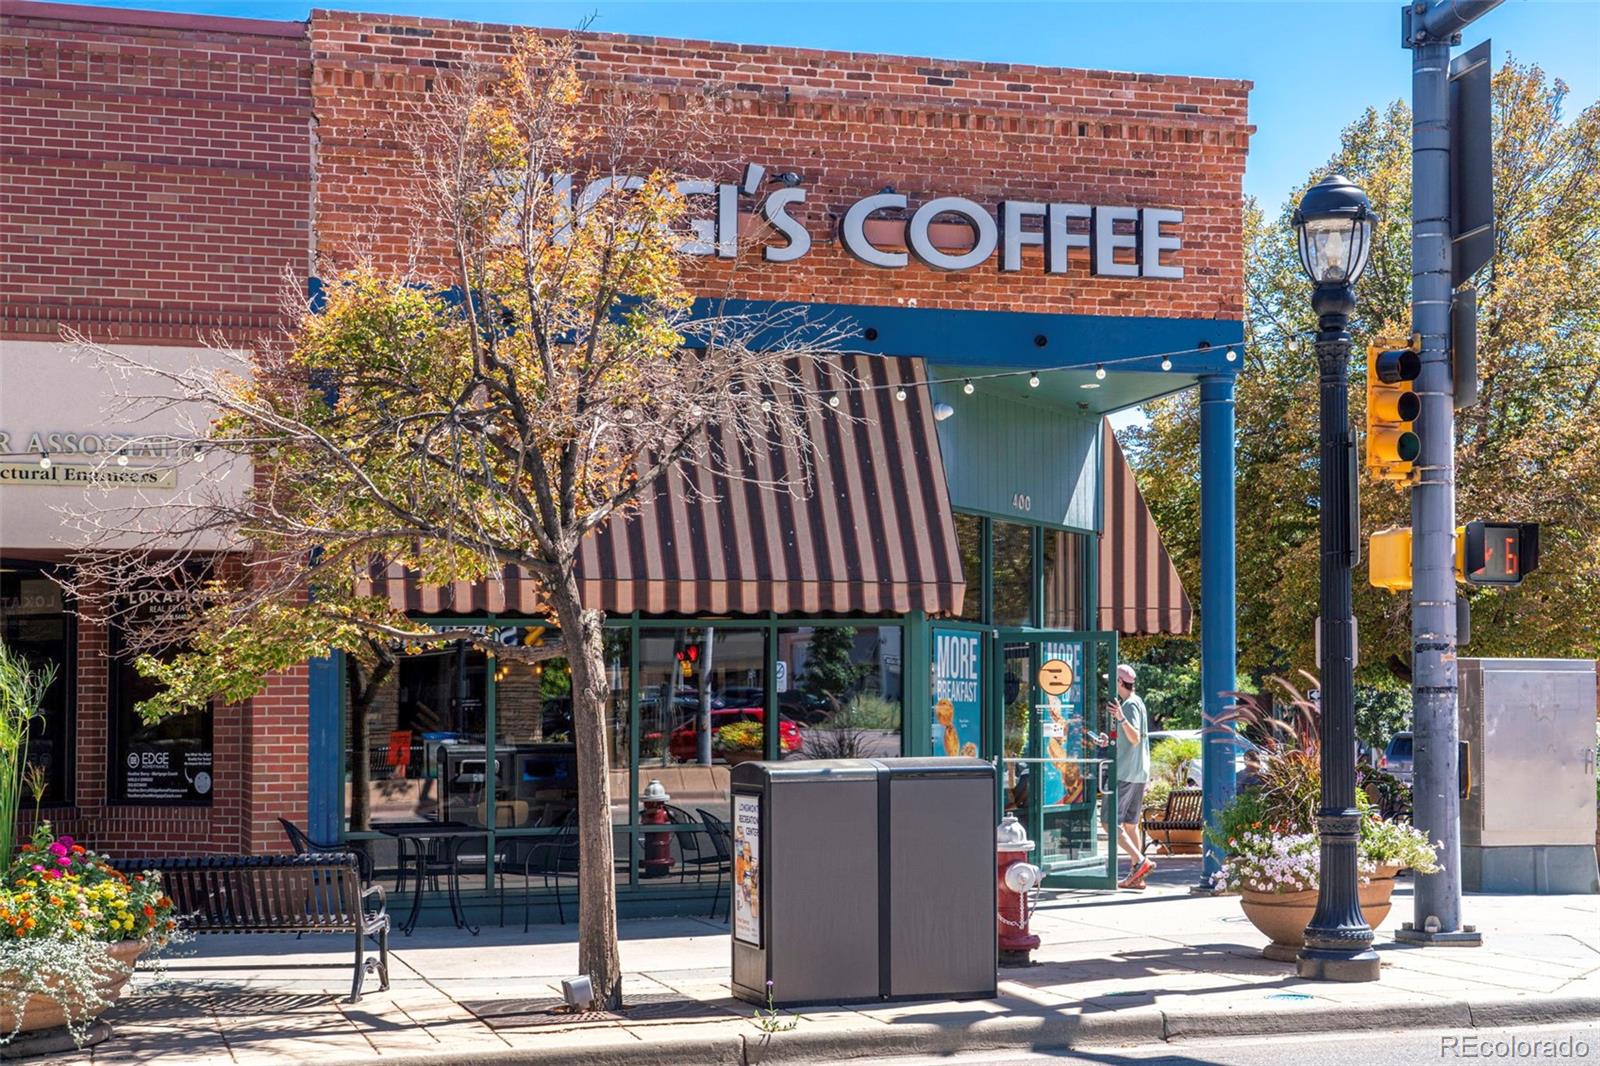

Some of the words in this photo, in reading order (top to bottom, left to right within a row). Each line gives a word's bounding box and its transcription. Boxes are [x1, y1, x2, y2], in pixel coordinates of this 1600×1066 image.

[839, 194, 1185, 279] COFFEE
[1012, 494, 1031, 512] 400
[149, 605, 165, 613] REAL
[937, 635, 978, 680] MORE
[937, 680, 978, 703] BREAKFAST
[141, 752, 169, 765] EDGE
